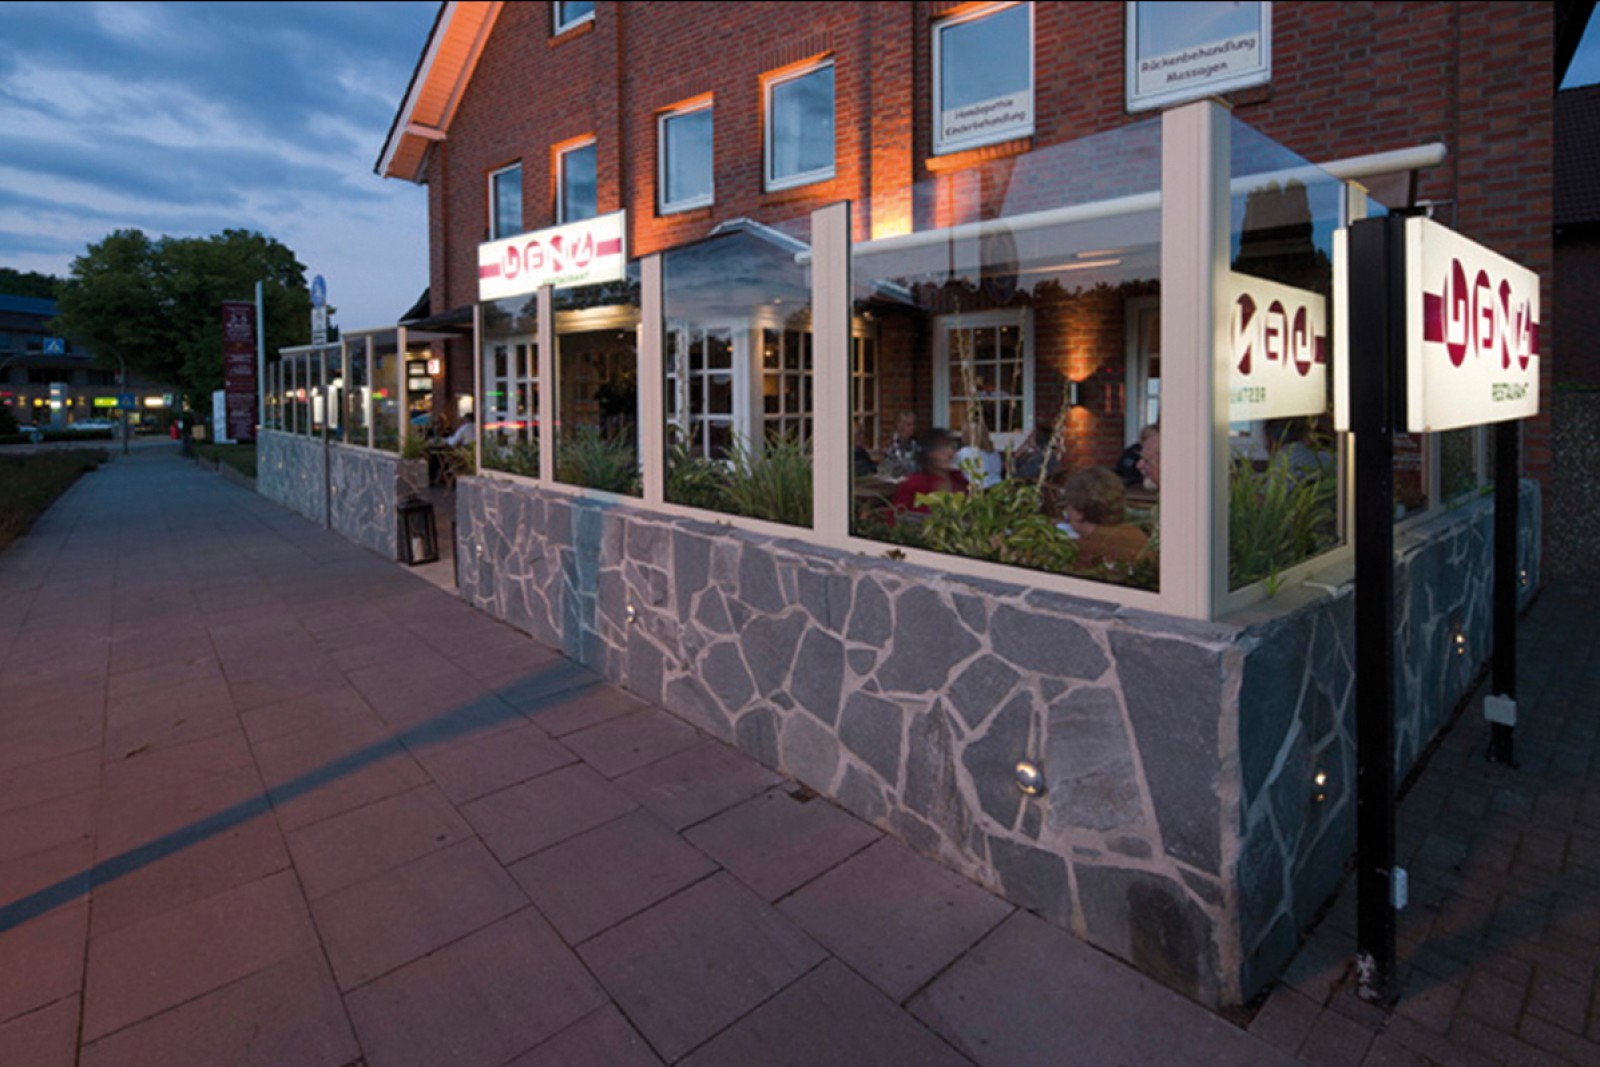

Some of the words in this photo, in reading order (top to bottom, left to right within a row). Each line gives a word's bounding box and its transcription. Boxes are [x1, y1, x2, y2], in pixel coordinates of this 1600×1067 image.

[1141, 37, 1256, 73] Rückenbehandlung
[1166, 61, 1228, 83] Massagen
[945, 111, 1026, 136] Kinderbehandlung
